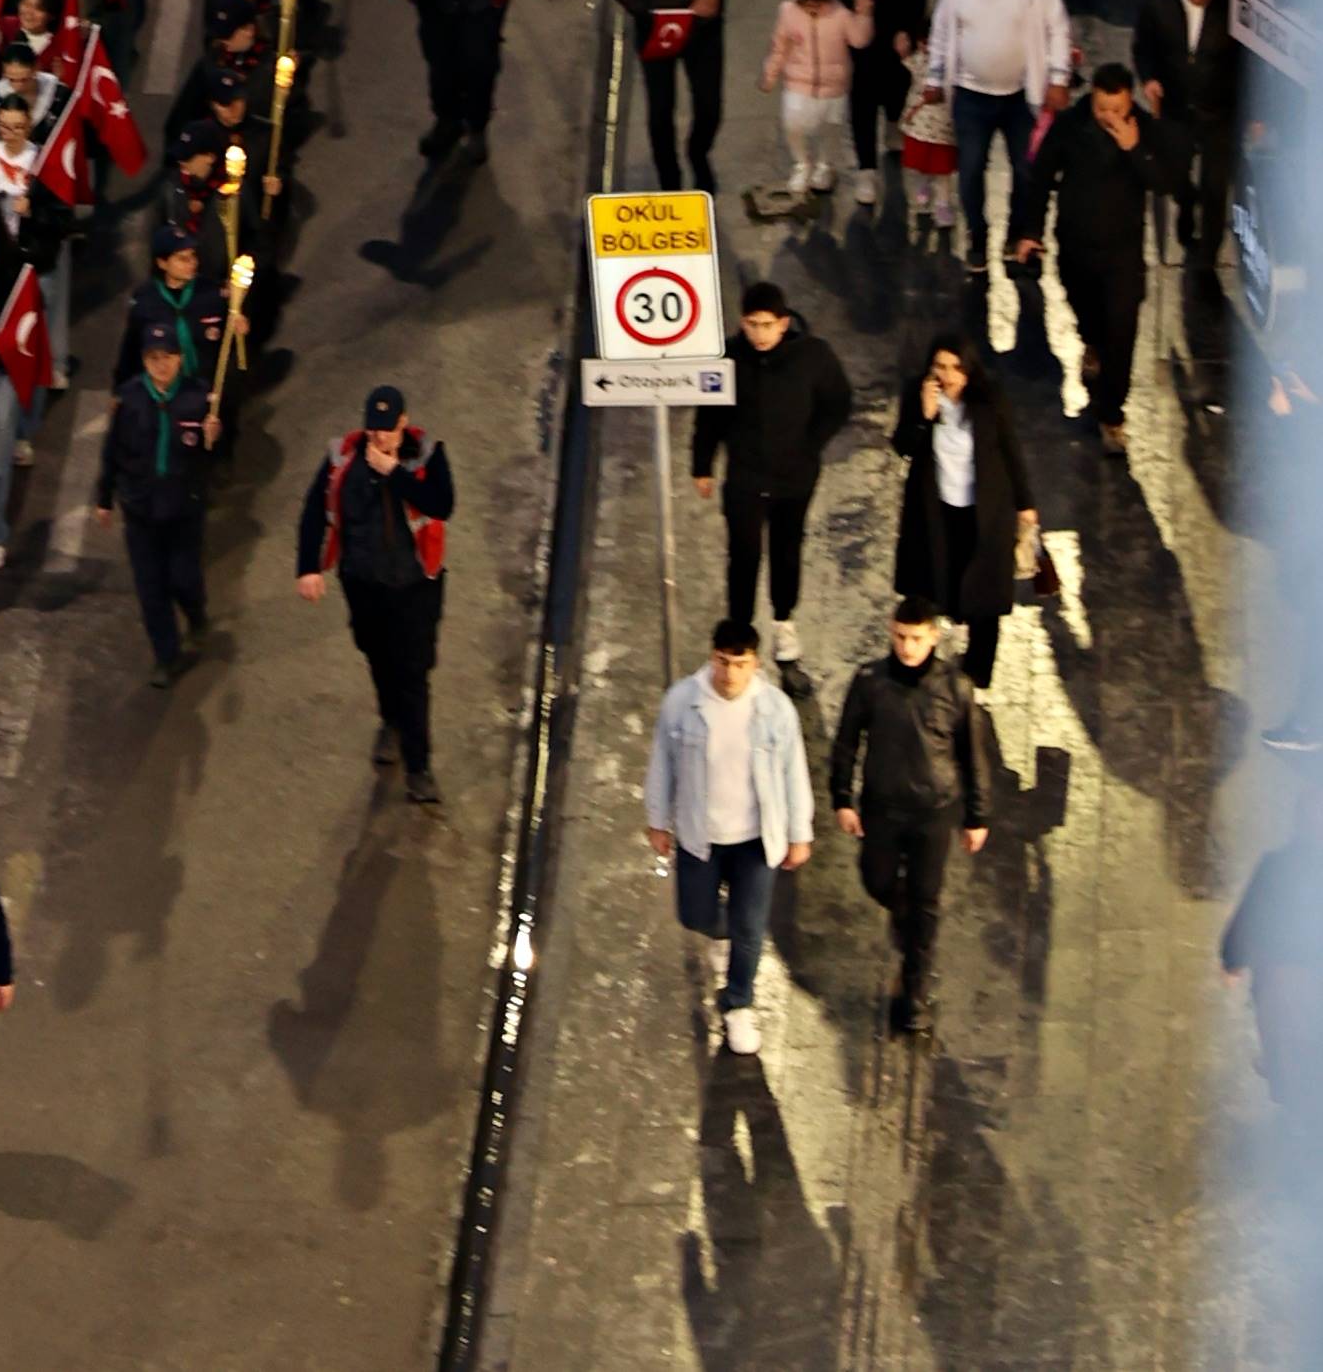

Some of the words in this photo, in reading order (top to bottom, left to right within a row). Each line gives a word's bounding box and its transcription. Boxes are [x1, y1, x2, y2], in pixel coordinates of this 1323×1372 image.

[616, 204, 683, 223] OKUL
[602, 229, 707, 251] BÖLGESİ
[633, 292, 683, 324] 30
